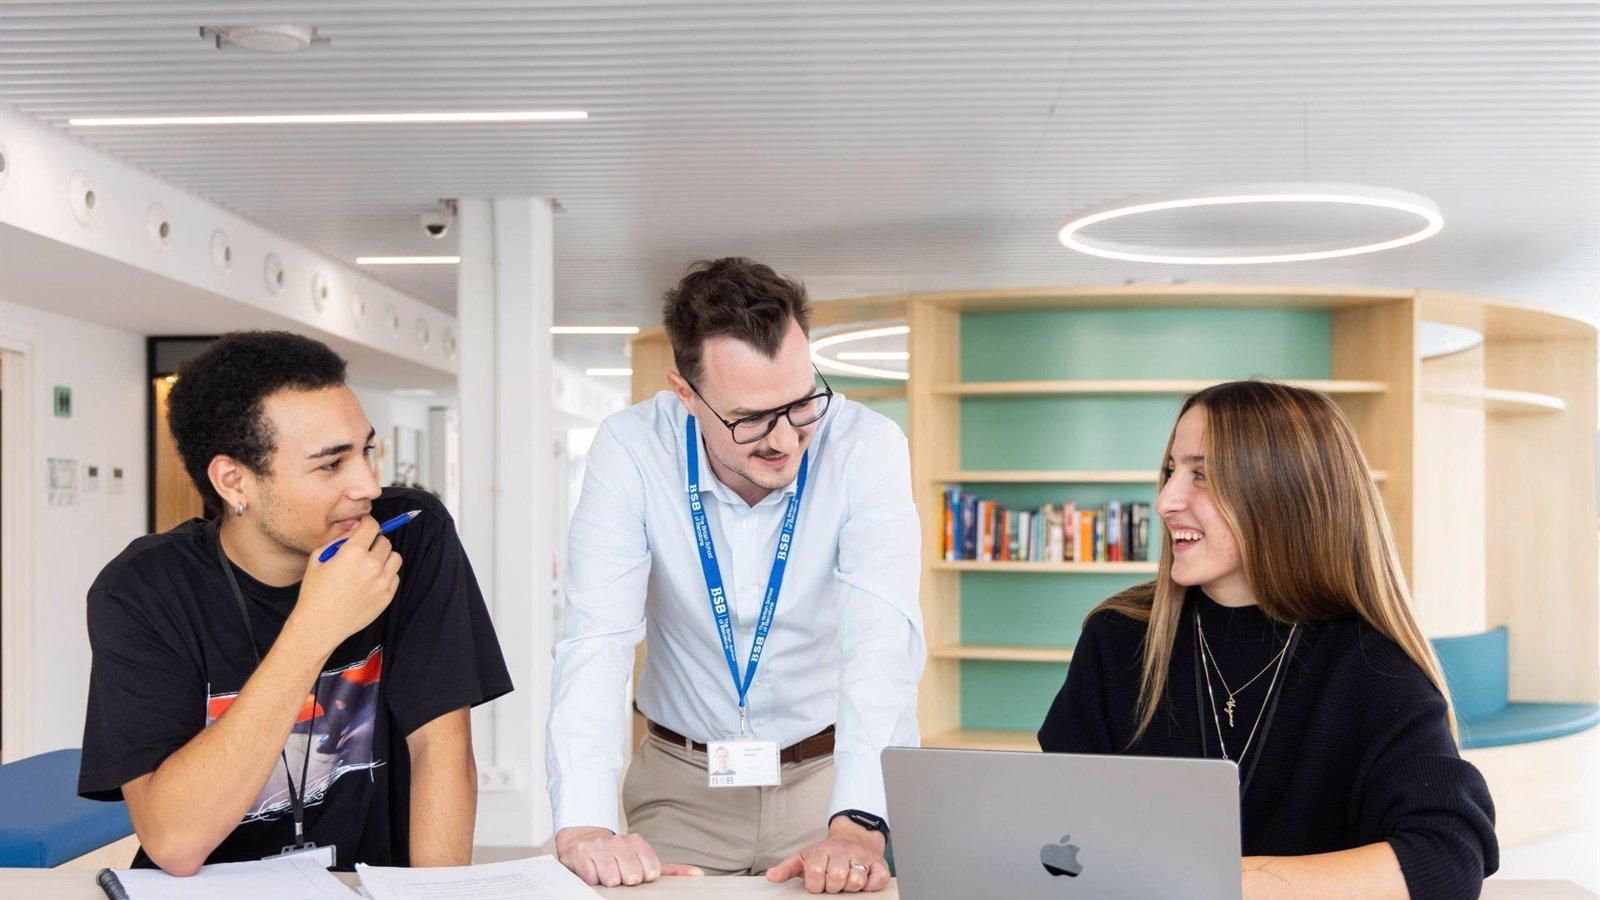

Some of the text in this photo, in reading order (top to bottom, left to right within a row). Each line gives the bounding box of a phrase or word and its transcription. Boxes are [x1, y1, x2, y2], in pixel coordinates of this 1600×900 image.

[689, 484, 701, 511] BSB
[704, 540, 713, 558] School
[777, 534, 791, 560] BSB
[710, 587, 726, 614] BSB
[751, 636, 764, 662] BSB
